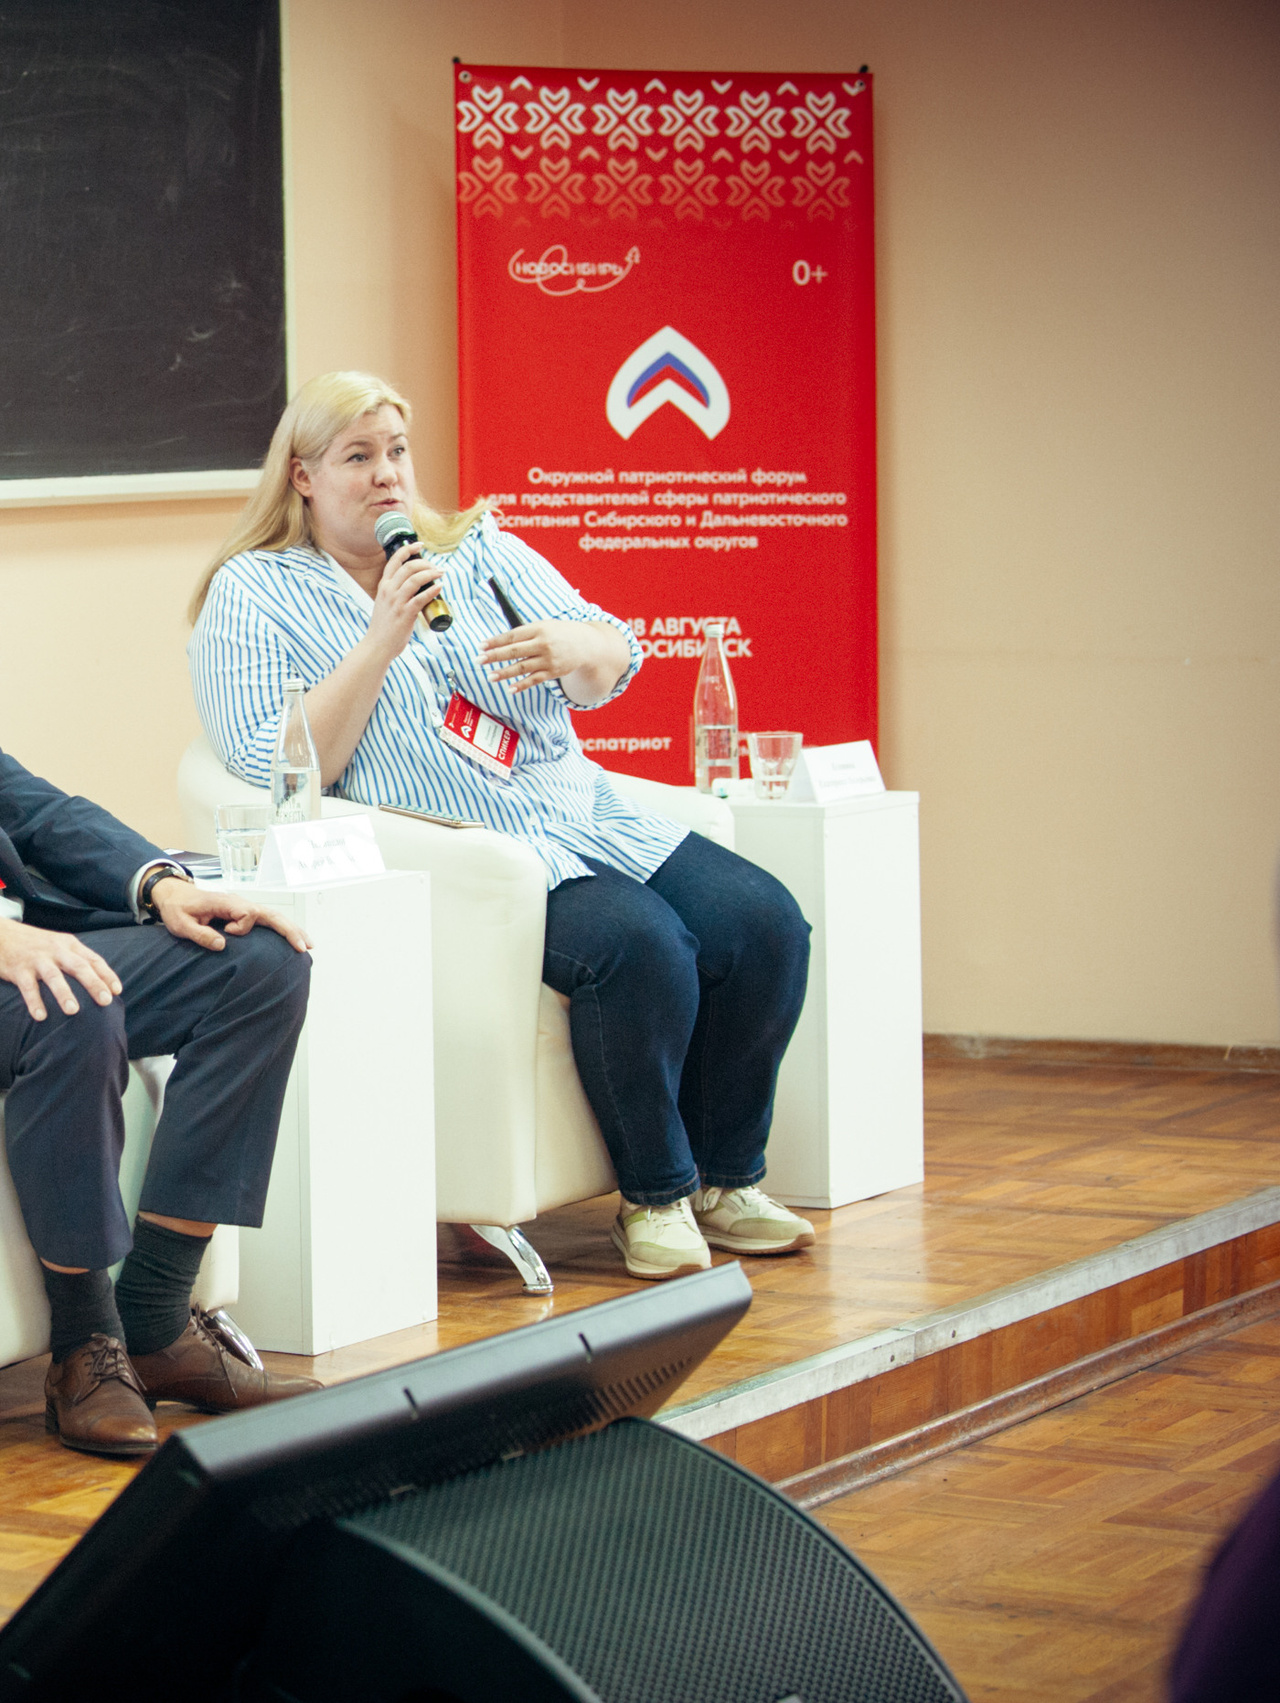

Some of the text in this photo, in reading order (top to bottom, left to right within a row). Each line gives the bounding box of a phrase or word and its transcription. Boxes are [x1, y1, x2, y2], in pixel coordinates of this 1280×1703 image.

[792, 259, 828, 286] 0+
[527, 466, 807, 488] Окружной патриотический форум
[521, 490, 650, 509] представителей
[653, 489, 709, 509] сферы
[713, 492, 847, 508] патриотического
[496, 510, 848, 531] оспитания Сибирского и Дальневосточного
[578, 532, 758, 552] федеральных округов
[498, 730, 511, 761] СПИКЕР
[577, 736, 672, 754] оспатриот
